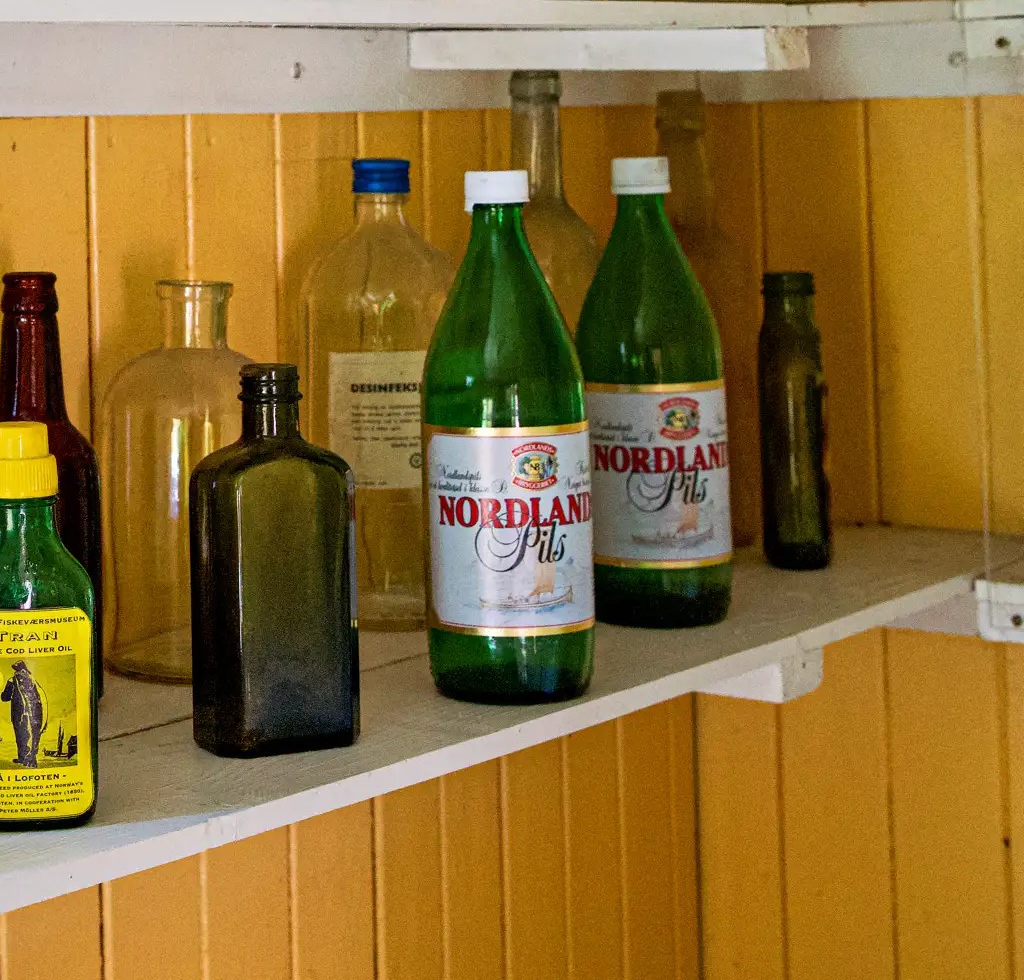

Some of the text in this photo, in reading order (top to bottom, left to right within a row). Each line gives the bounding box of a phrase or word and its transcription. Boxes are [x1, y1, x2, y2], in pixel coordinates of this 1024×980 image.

[627, 462, 708, 513] Pils
[475, 511, 567, 573] Pils
[5, 647, 26, 655] COD
[28, 646, 55, 654] LIVER
[14, 773, 60, 782] LOFOTEN
